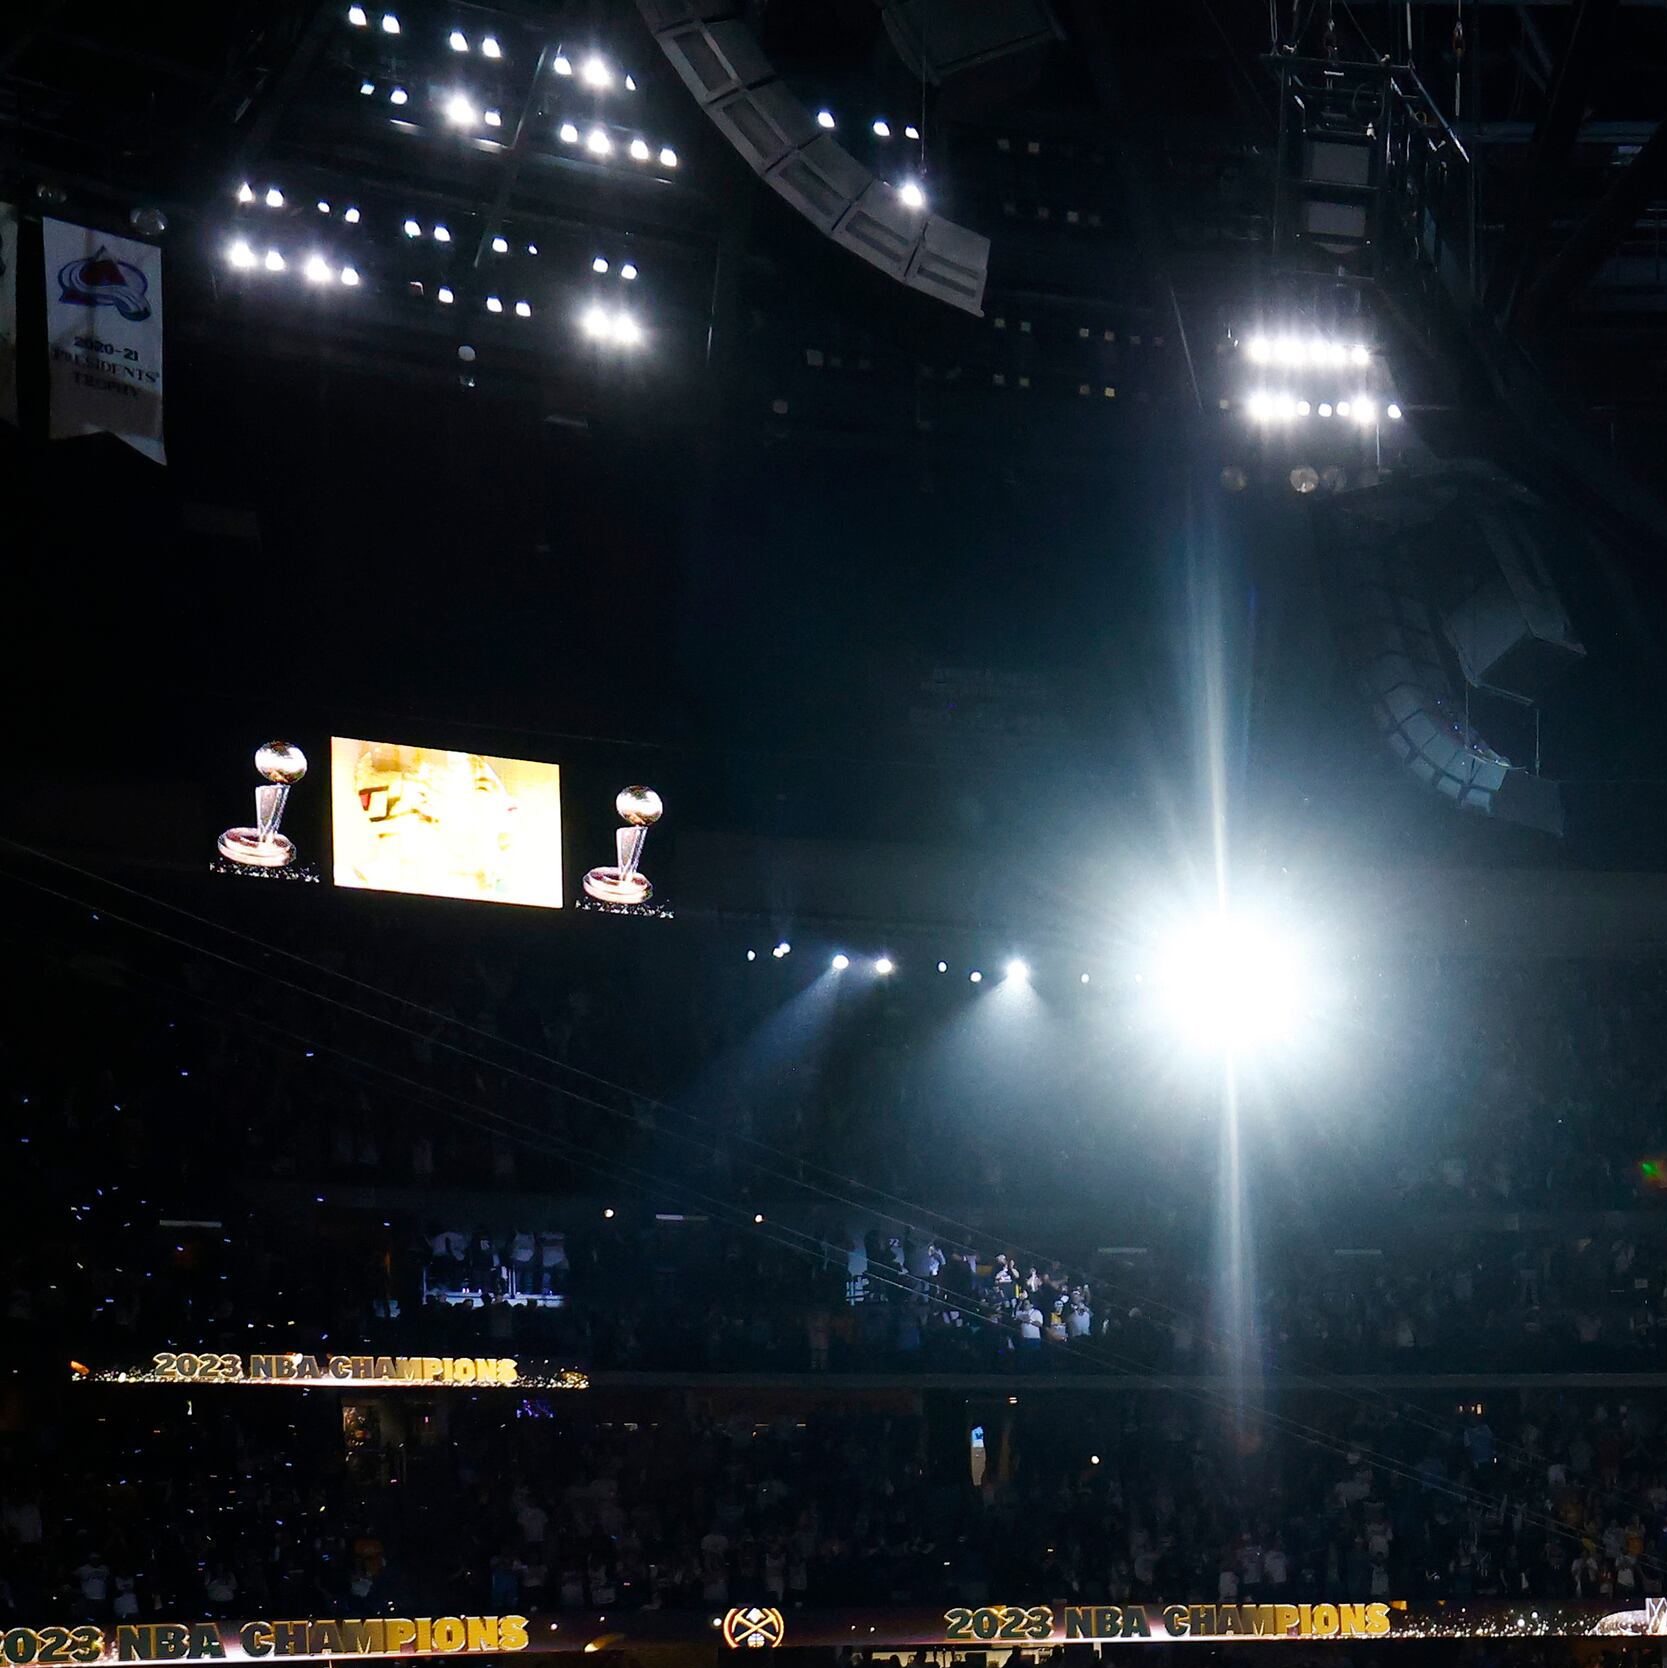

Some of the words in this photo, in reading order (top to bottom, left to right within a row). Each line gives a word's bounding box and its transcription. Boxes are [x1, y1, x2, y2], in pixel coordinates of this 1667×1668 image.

[152, 1352, 243, 1378] 2023
[249, 1353, 320, 1379] NBA
[326, 1354, 519, 1383] CHAMPIONS
[116, 1623, 225, 1662] NBA
[239, 1615, 531, 1658] CHAMPIONS
[943, 1604, 1053, 1640] 2023
[1064, 1606, 1152, 1640] NBA
[1163, 1602, 1391, 1639] CHAMPIONS
